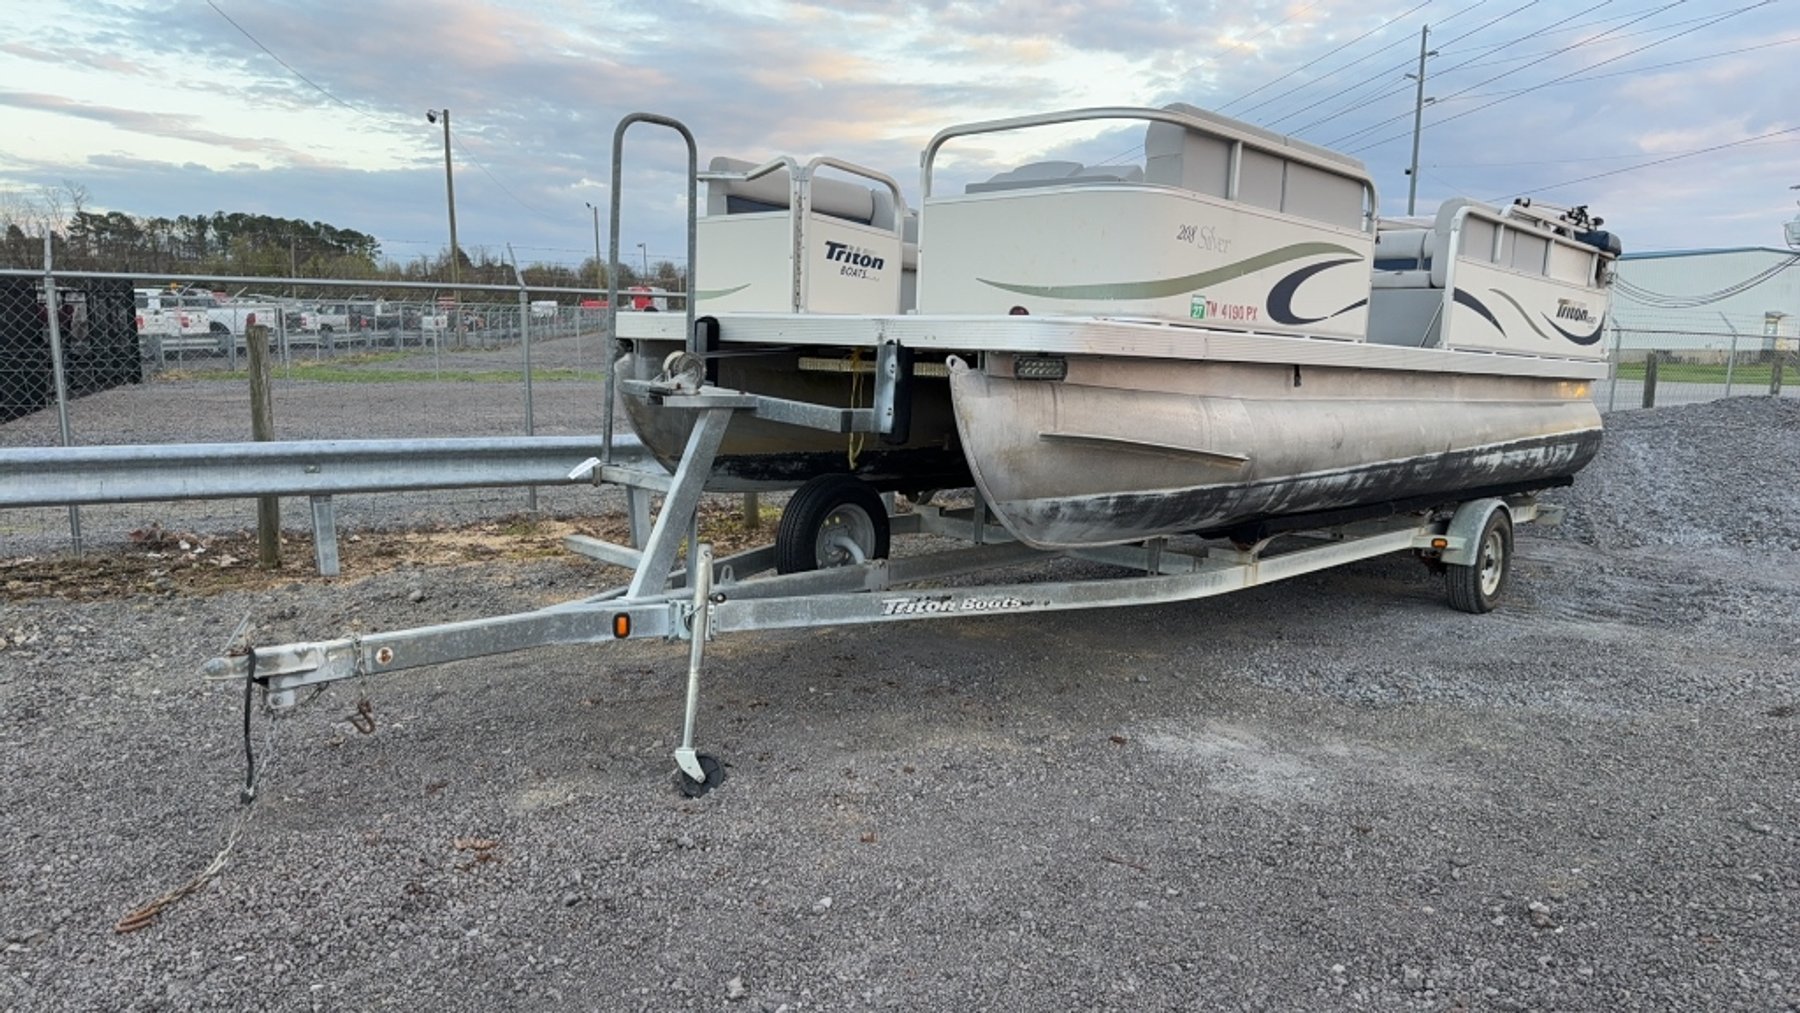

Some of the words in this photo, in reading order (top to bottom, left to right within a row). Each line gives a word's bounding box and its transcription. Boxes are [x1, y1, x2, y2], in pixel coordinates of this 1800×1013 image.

[825, 240, 885, 270] Triton
[1192, 305, 1204, 319] 27
[1221, 303, 1244, 320] 4190
[1246, 305, 1258, 321] PX
[1556, 298, 1588, 321] Triton
[881, 597, 957, 616] Triton
[960, 597, 1022, 612] Boats
